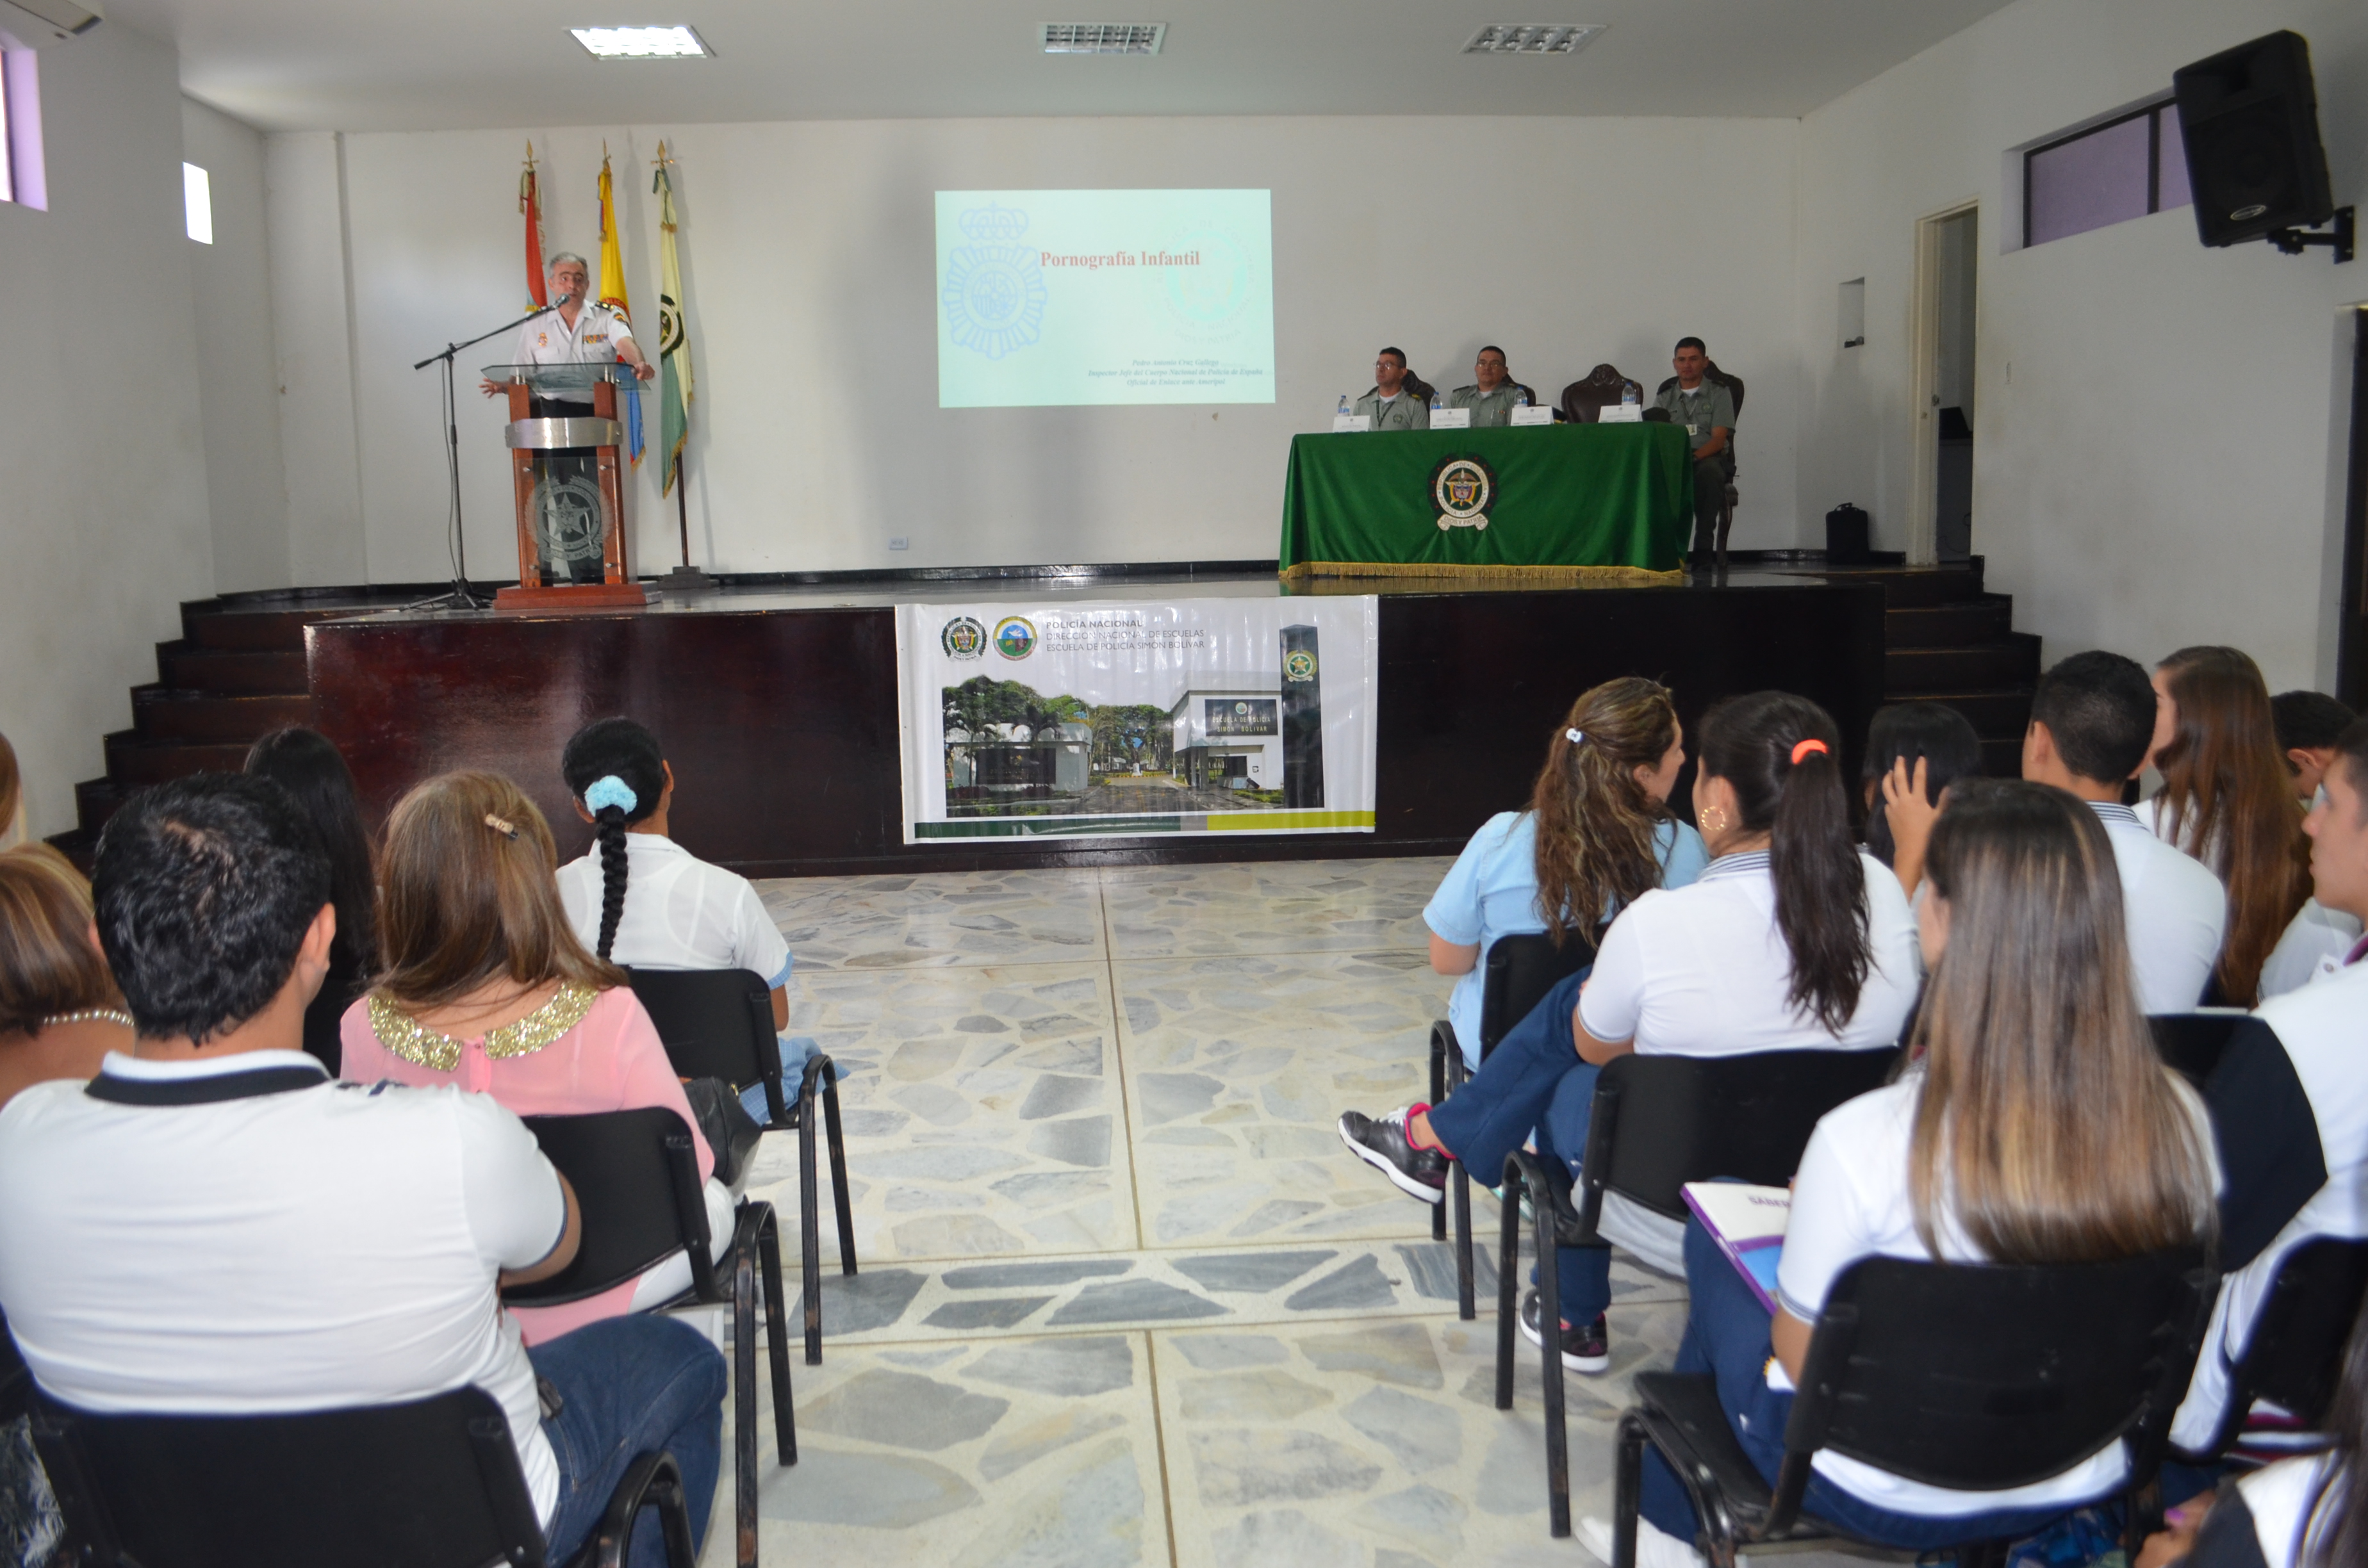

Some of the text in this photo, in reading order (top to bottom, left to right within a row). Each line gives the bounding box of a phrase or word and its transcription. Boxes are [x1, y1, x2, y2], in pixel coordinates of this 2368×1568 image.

[1040, 250, 1200, 270] Pornografía Infantil
[1195, 359, 1219, 368] Gallego
[1088, 370, 1118, 378] Inspector
[1119, 370, 1132, 378] Jefe
[1144, 369, 1168, 377] Cuerpo
[1126, 379, 1148, 387] Oficial
[1196, 378, 1226, 387] Ameripol
[1046, 619, 1087, 629] POLICÍA
[1089, 619, 1142, 628] NACIONAL
[1099, 630, 1147, 640] NACIONAL
[1162, 629, 1205, 637] ESCUELAS
[1046, 643, 1084, 652] ESCUELA
[1169, 640, 1205, 649] BOLÍVAR
